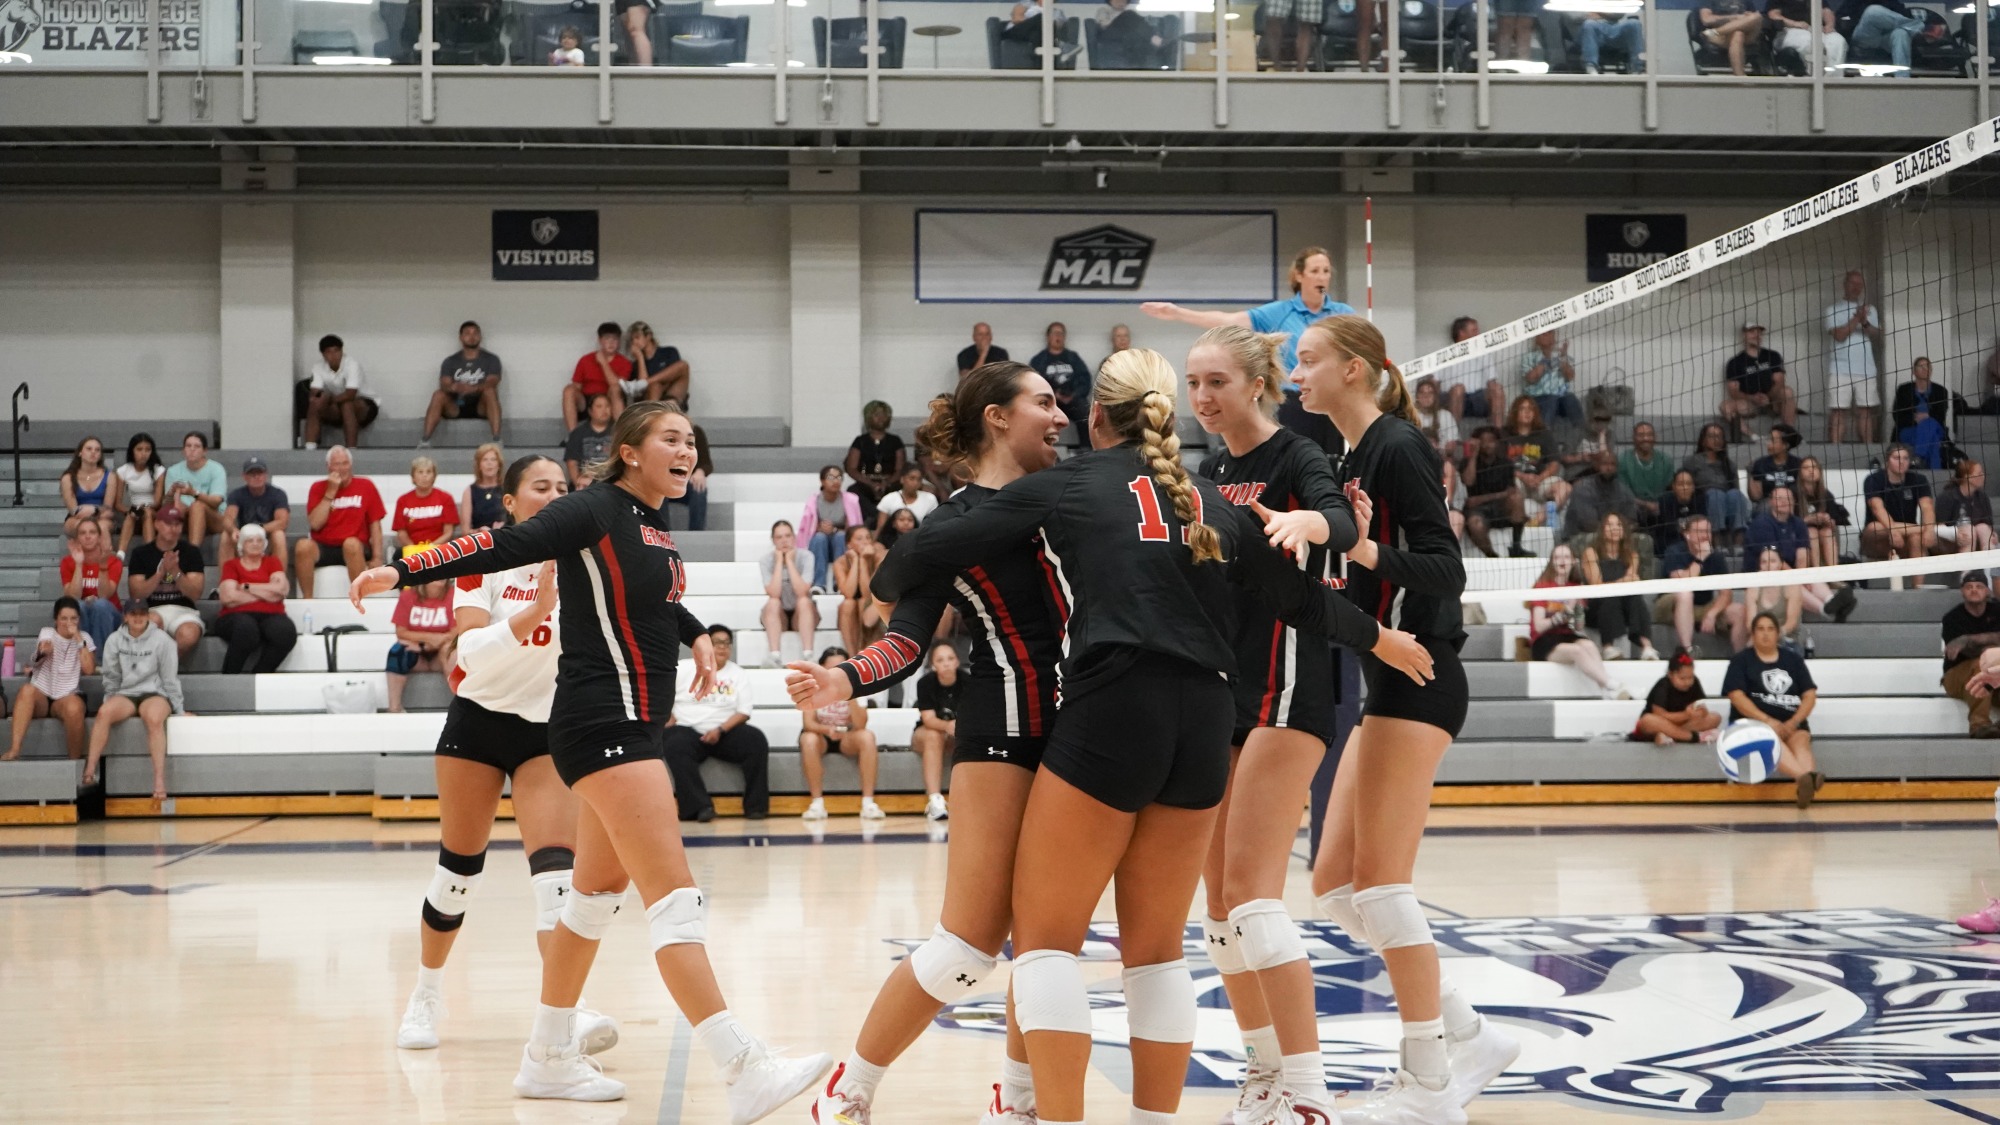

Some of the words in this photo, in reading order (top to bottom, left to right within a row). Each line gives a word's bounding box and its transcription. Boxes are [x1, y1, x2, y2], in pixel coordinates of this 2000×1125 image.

[43, 0, 101, 23] HOOD
[105, 0, 199, 23] COLEGE
[1715, 225, 1755, 257] BLAZERS
[1783, 202, 1811, 231] HOOD
[1813, 181, 1859, 218] COLLEGE
[1895, 140, 1951, 184] BLAZERS
[497, 249, 595, 266] VISITORS
[1048, 258, 1142, 285] MAC
[666, 556, 687, 603] 14
[409, 605, 449, 628] CUA
